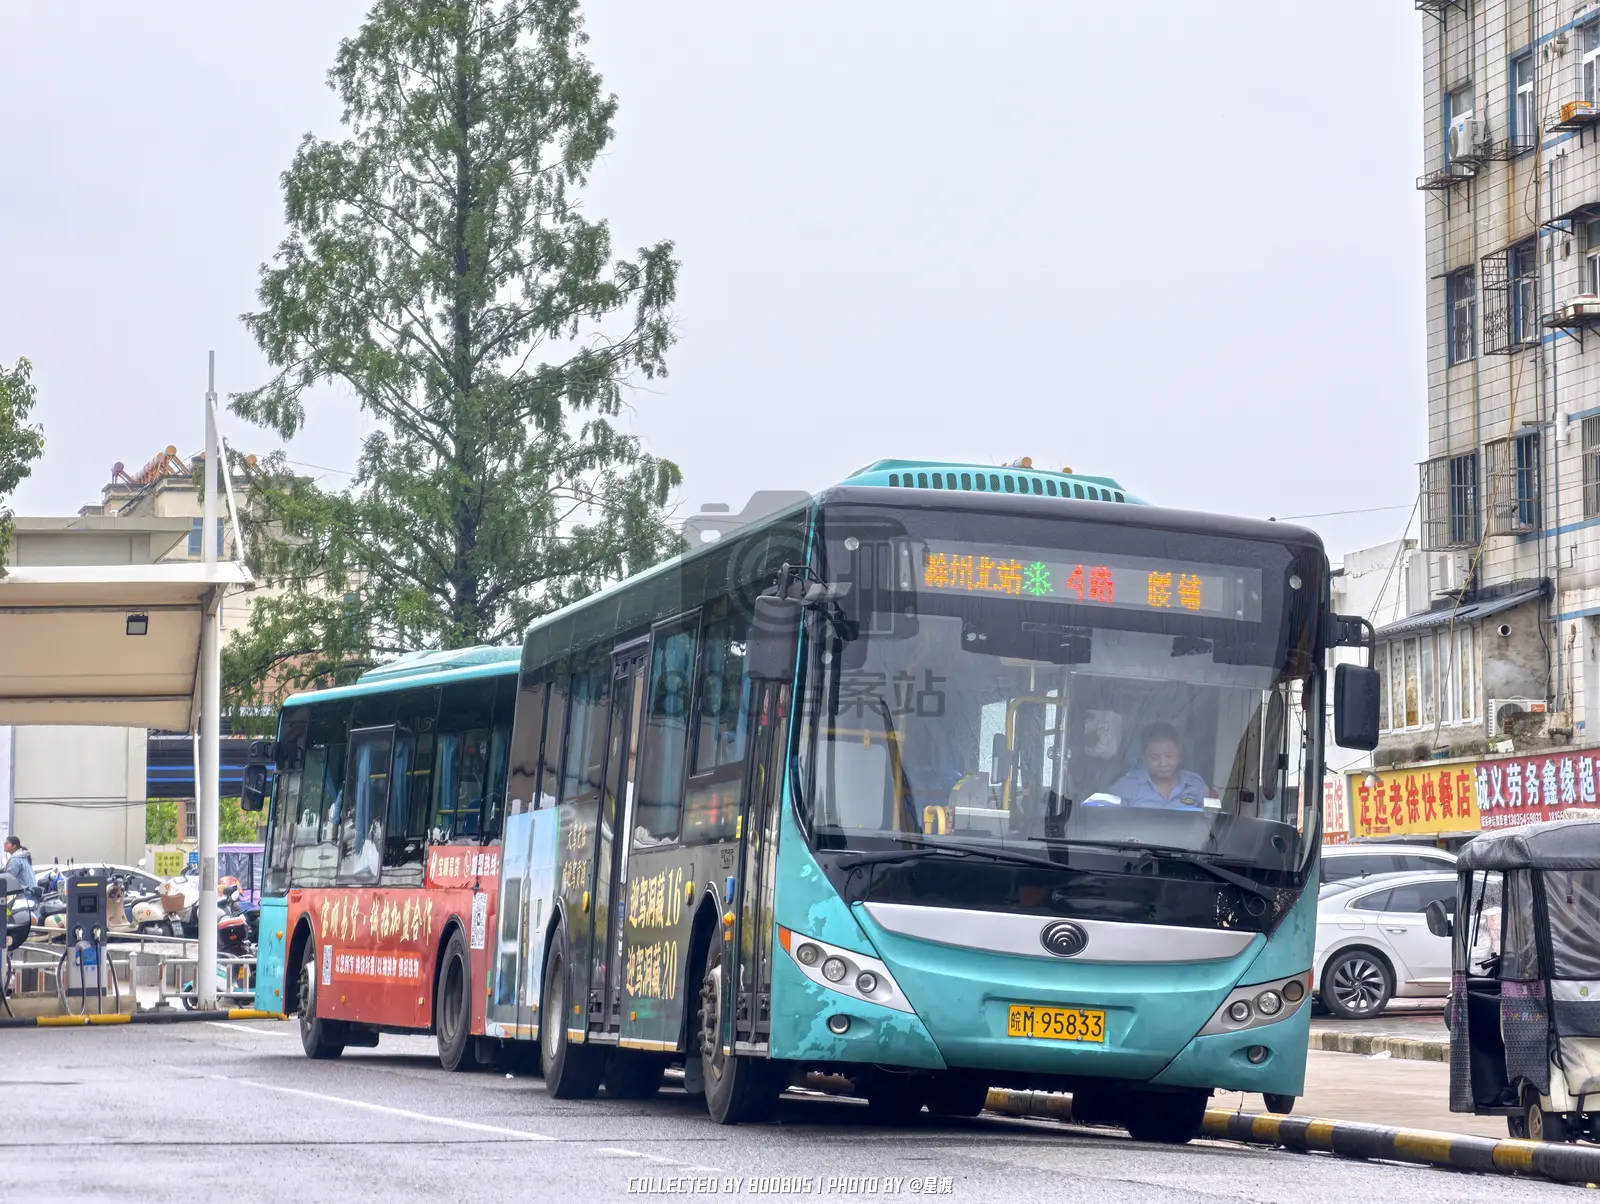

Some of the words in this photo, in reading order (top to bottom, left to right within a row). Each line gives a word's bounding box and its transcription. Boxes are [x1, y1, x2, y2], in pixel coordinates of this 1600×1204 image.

[1067, 564, 1114, 605] 4路
[1358, 769, 1471, 826] 定远老徐快餐店
